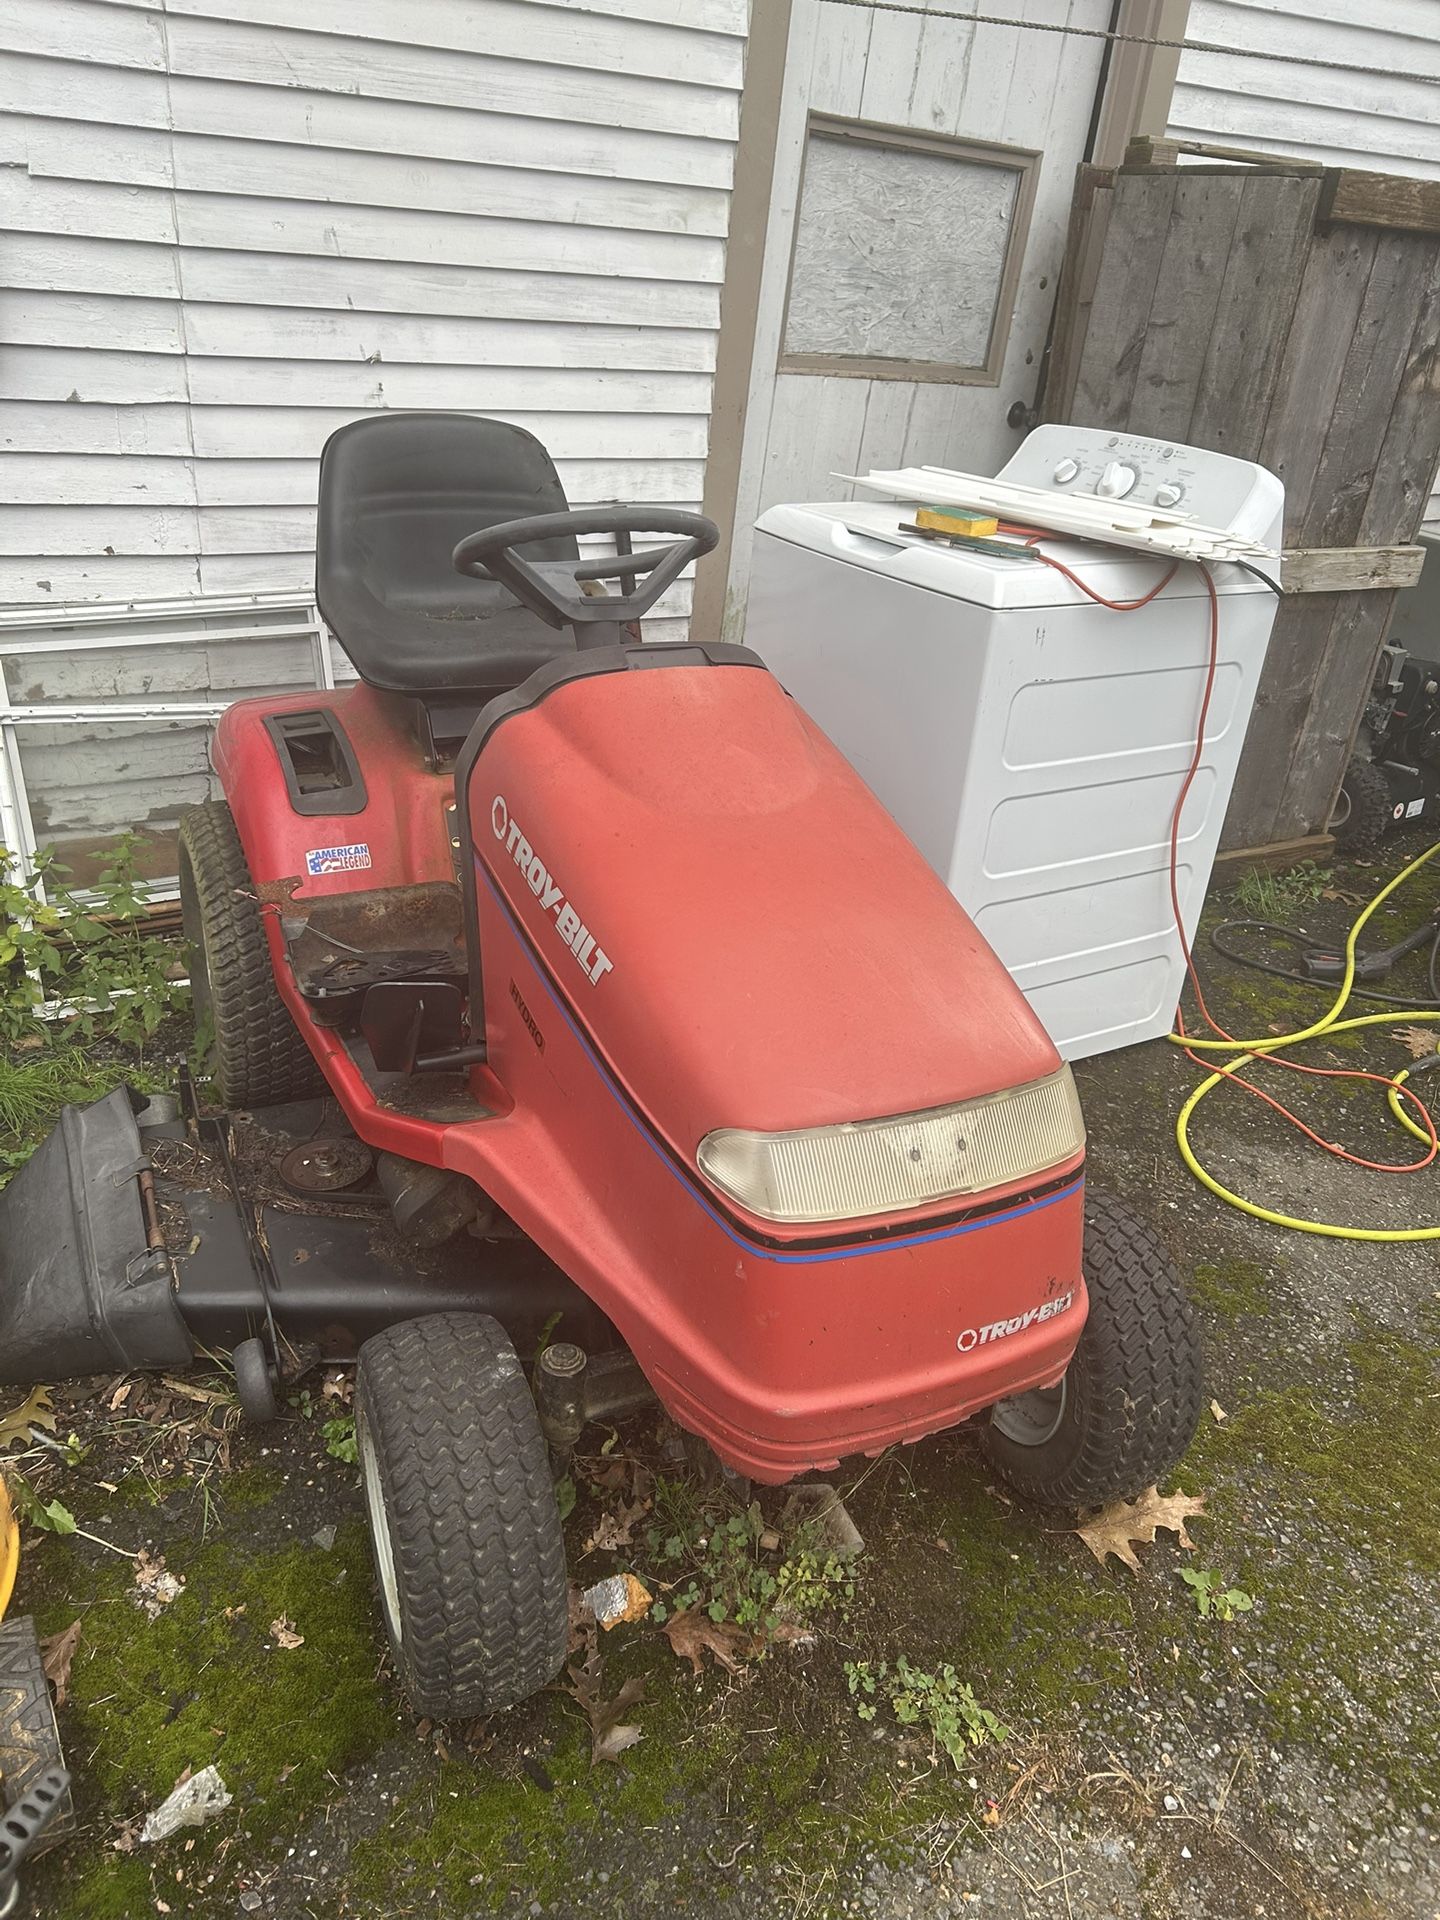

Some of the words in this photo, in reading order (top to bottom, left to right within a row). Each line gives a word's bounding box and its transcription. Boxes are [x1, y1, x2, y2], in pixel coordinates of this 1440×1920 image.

[315, 845, 367, 859] AMERICAN
[340, 854, 370, 869] LEGEND
[506, 818, 614, 986] TROY-BILT
[511, 983, 543, 1048] HYDRO
